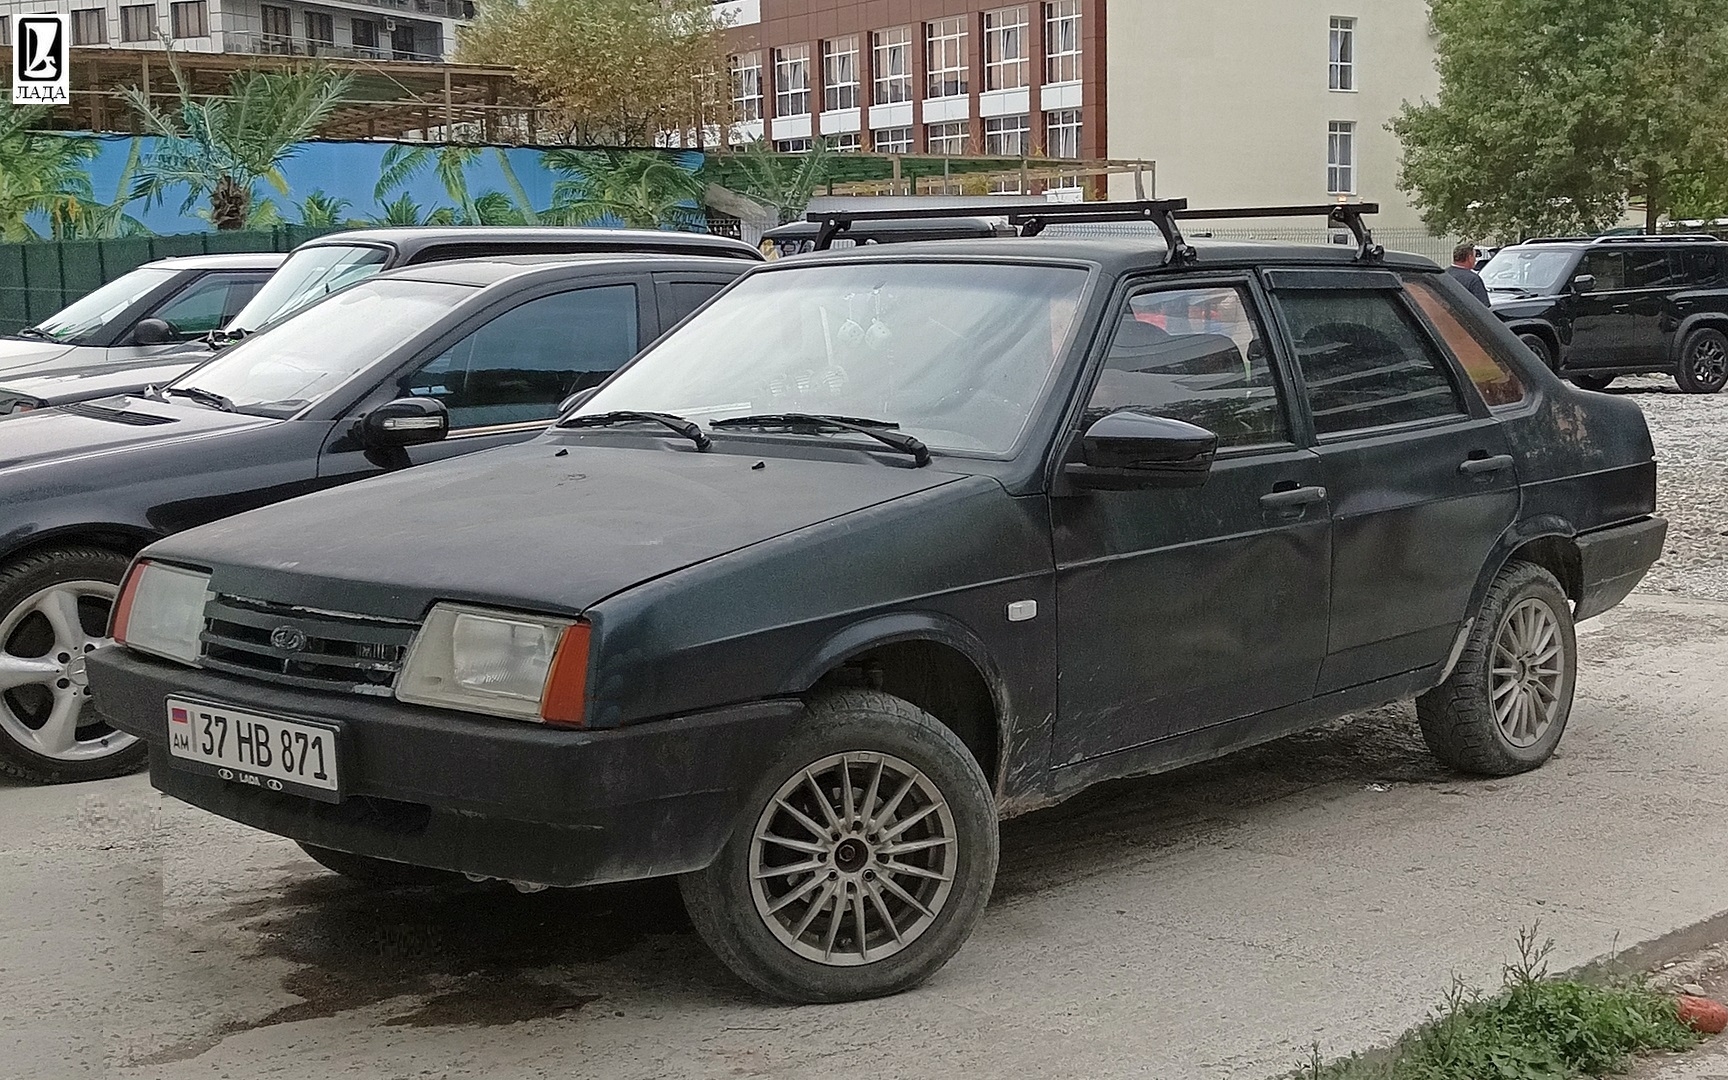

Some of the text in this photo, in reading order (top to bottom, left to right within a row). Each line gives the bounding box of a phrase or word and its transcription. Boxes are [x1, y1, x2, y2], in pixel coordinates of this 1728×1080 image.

[173, 732, 190, 752] AM
[200, 713, 328, 781] 37 HB 871
[239, 773, 261, 786] LADA
